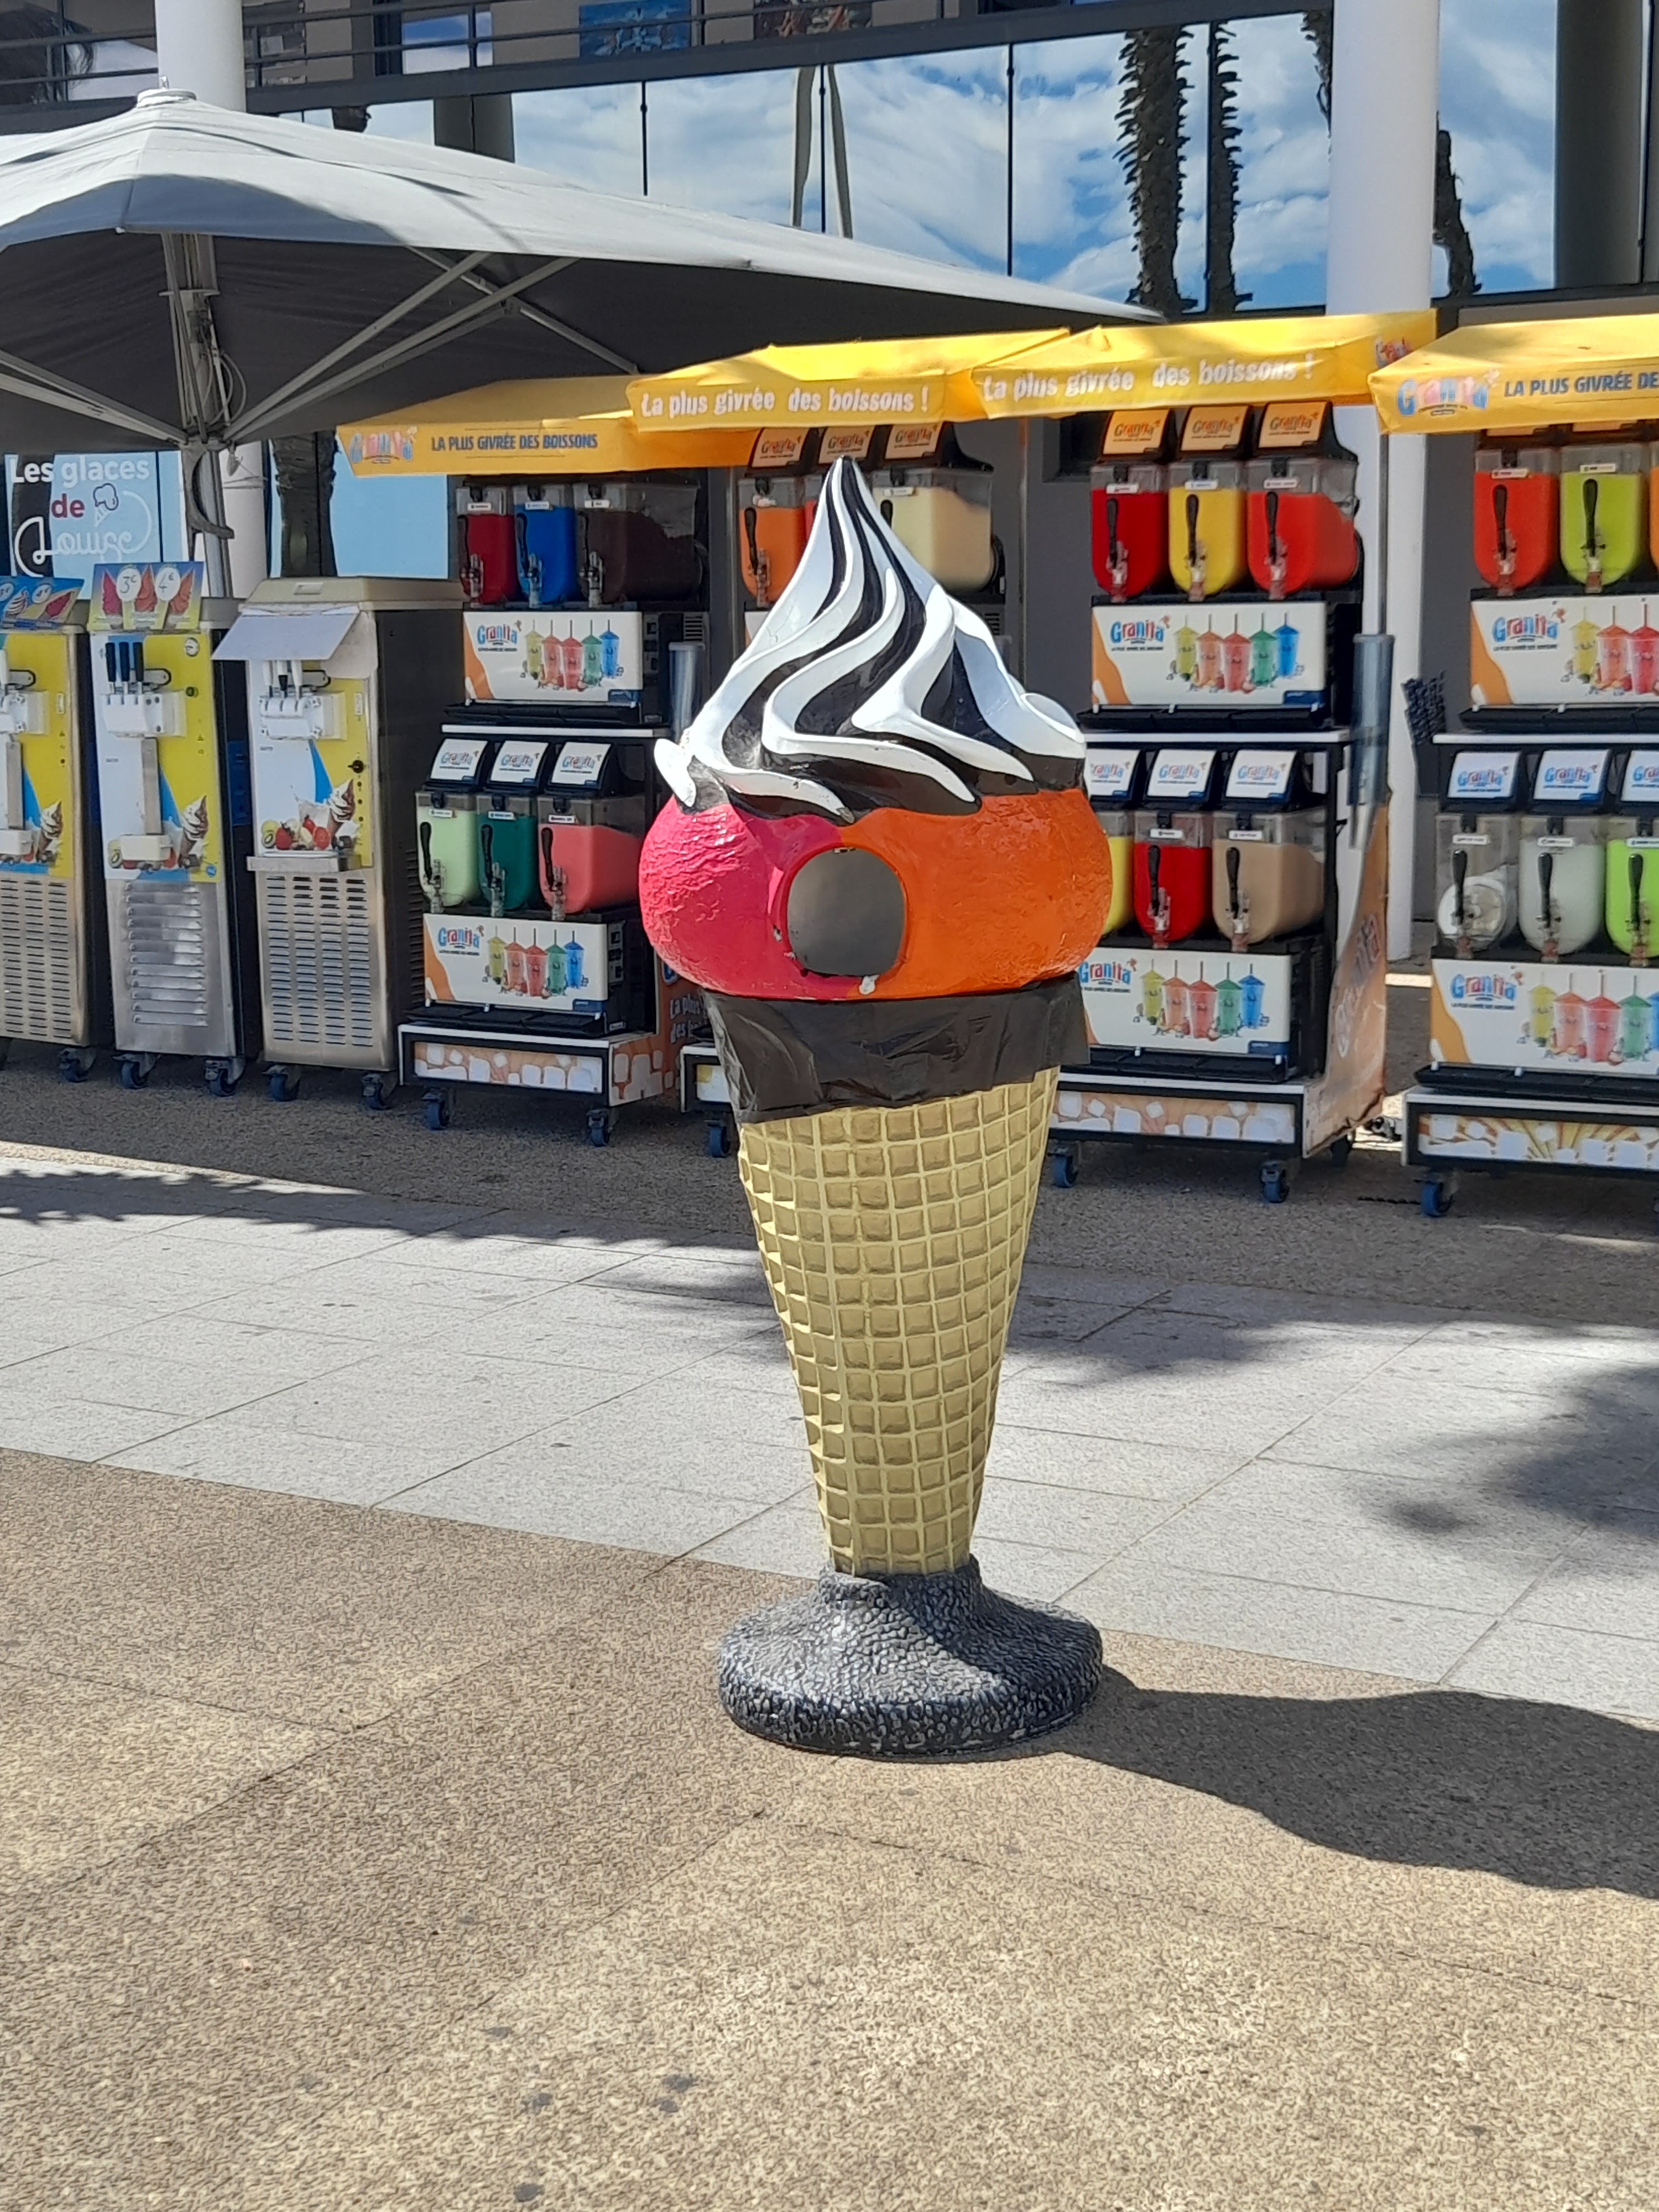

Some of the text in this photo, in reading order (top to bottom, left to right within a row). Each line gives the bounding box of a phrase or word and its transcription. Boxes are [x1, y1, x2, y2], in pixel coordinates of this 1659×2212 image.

[983, 374, 1006, 402] La
[1013, 371, 1057, 401] plus
[1065, 367, 1134, 397] givrée
[1151, 363, 1190, 388] des
[1198, 358, 1296, 385] boissons
[1504, 371, 1659, 398] LA PLUS GIVRÉE DE
[641, 393, 662, 417] La
[669, 390, 707, 419] plus
[713, 386, 775, 416] givrée
[788, 387, 821, 413] des
[828, 386, 914, 413] boissons
[431, 432, 598, 451] LA PLUS GIVRÉE DES BOISSONS
[10, 456, 150, 488] Les glaces
[51, 493, 85, 518] de
[477, 623, 518, 645] Granita
[1110, 619, 1164, 643] Granita
[1493, 614, 1558, 643] Granita
[439, 927, 480, 948] Granita
[1079, 961, 1131, 985] Granita
[1451, 974, 1517, 1001] Granita
